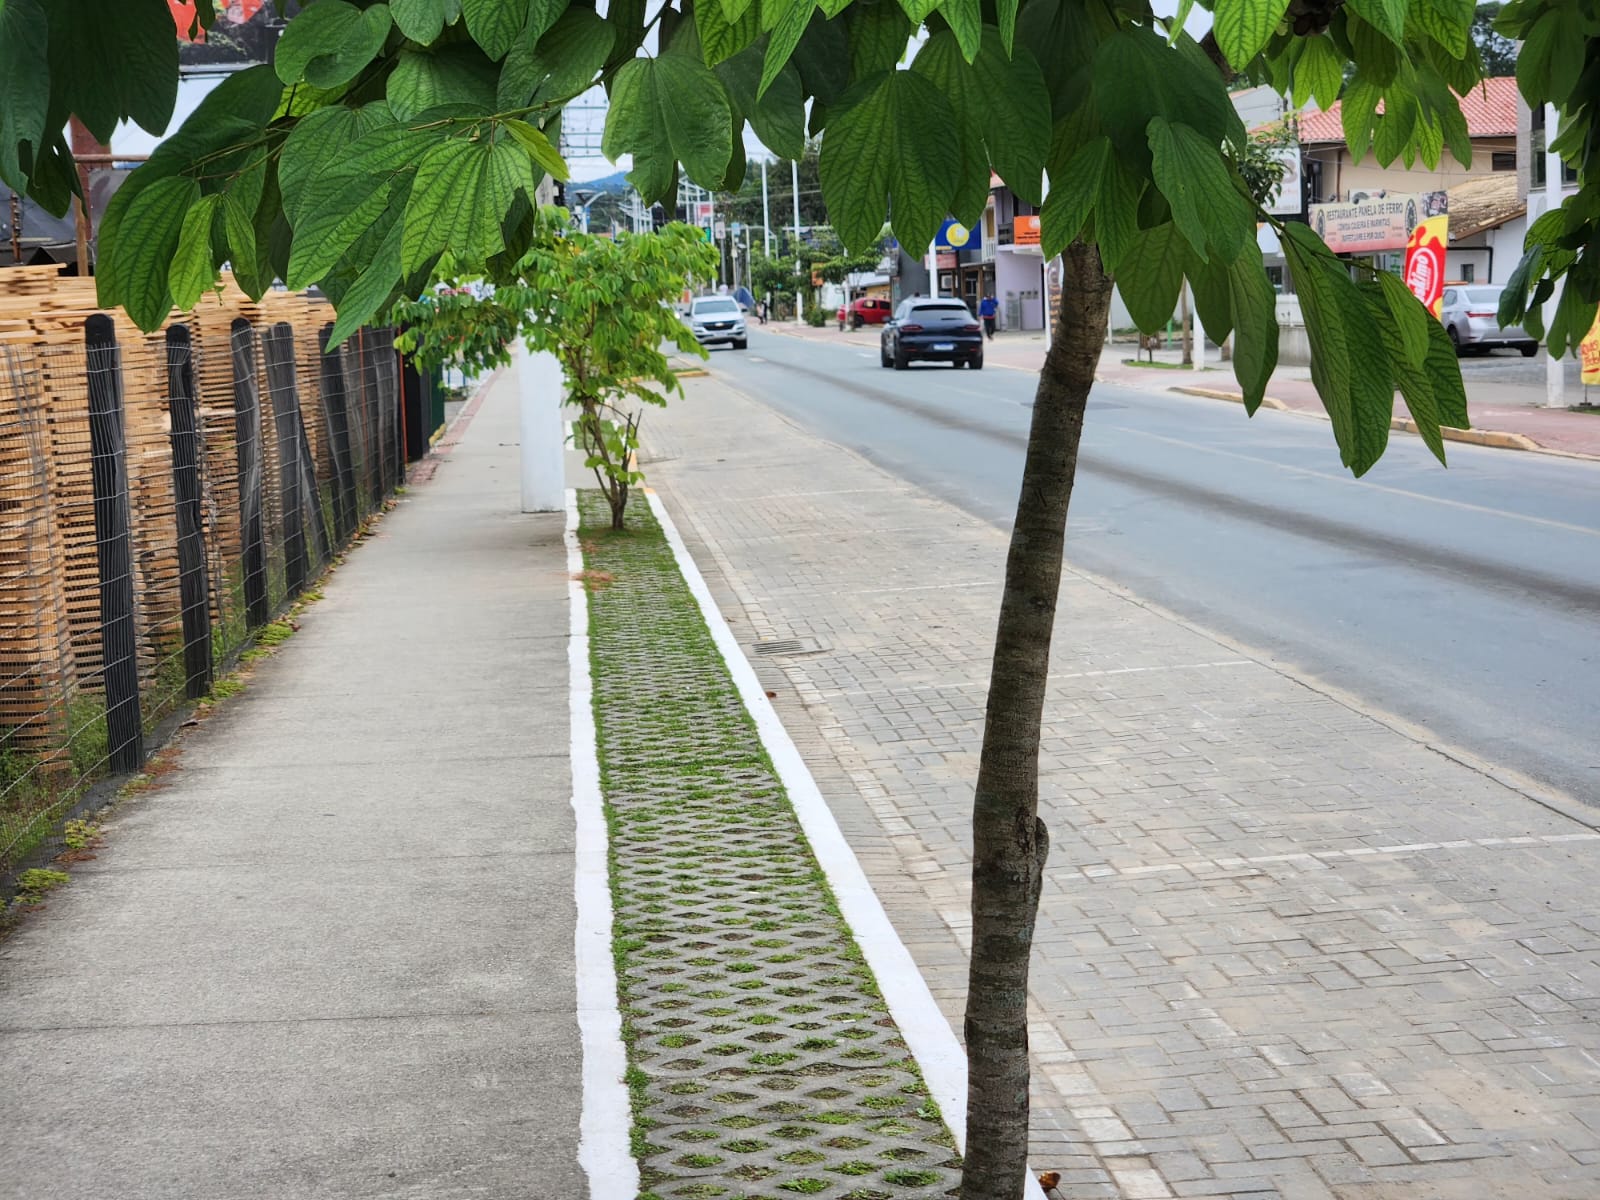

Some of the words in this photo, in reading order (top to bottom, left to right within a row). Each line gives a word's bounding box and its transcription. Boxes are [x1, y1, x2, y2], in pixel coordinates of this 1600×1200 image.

[1327, 206, 1358, 221] RESTAURANTE
[1358, 204, 1377, 217] PANELA
[1378, 203, 1385, 215] DE
[1385, 202, 1403, 215] FERRO
